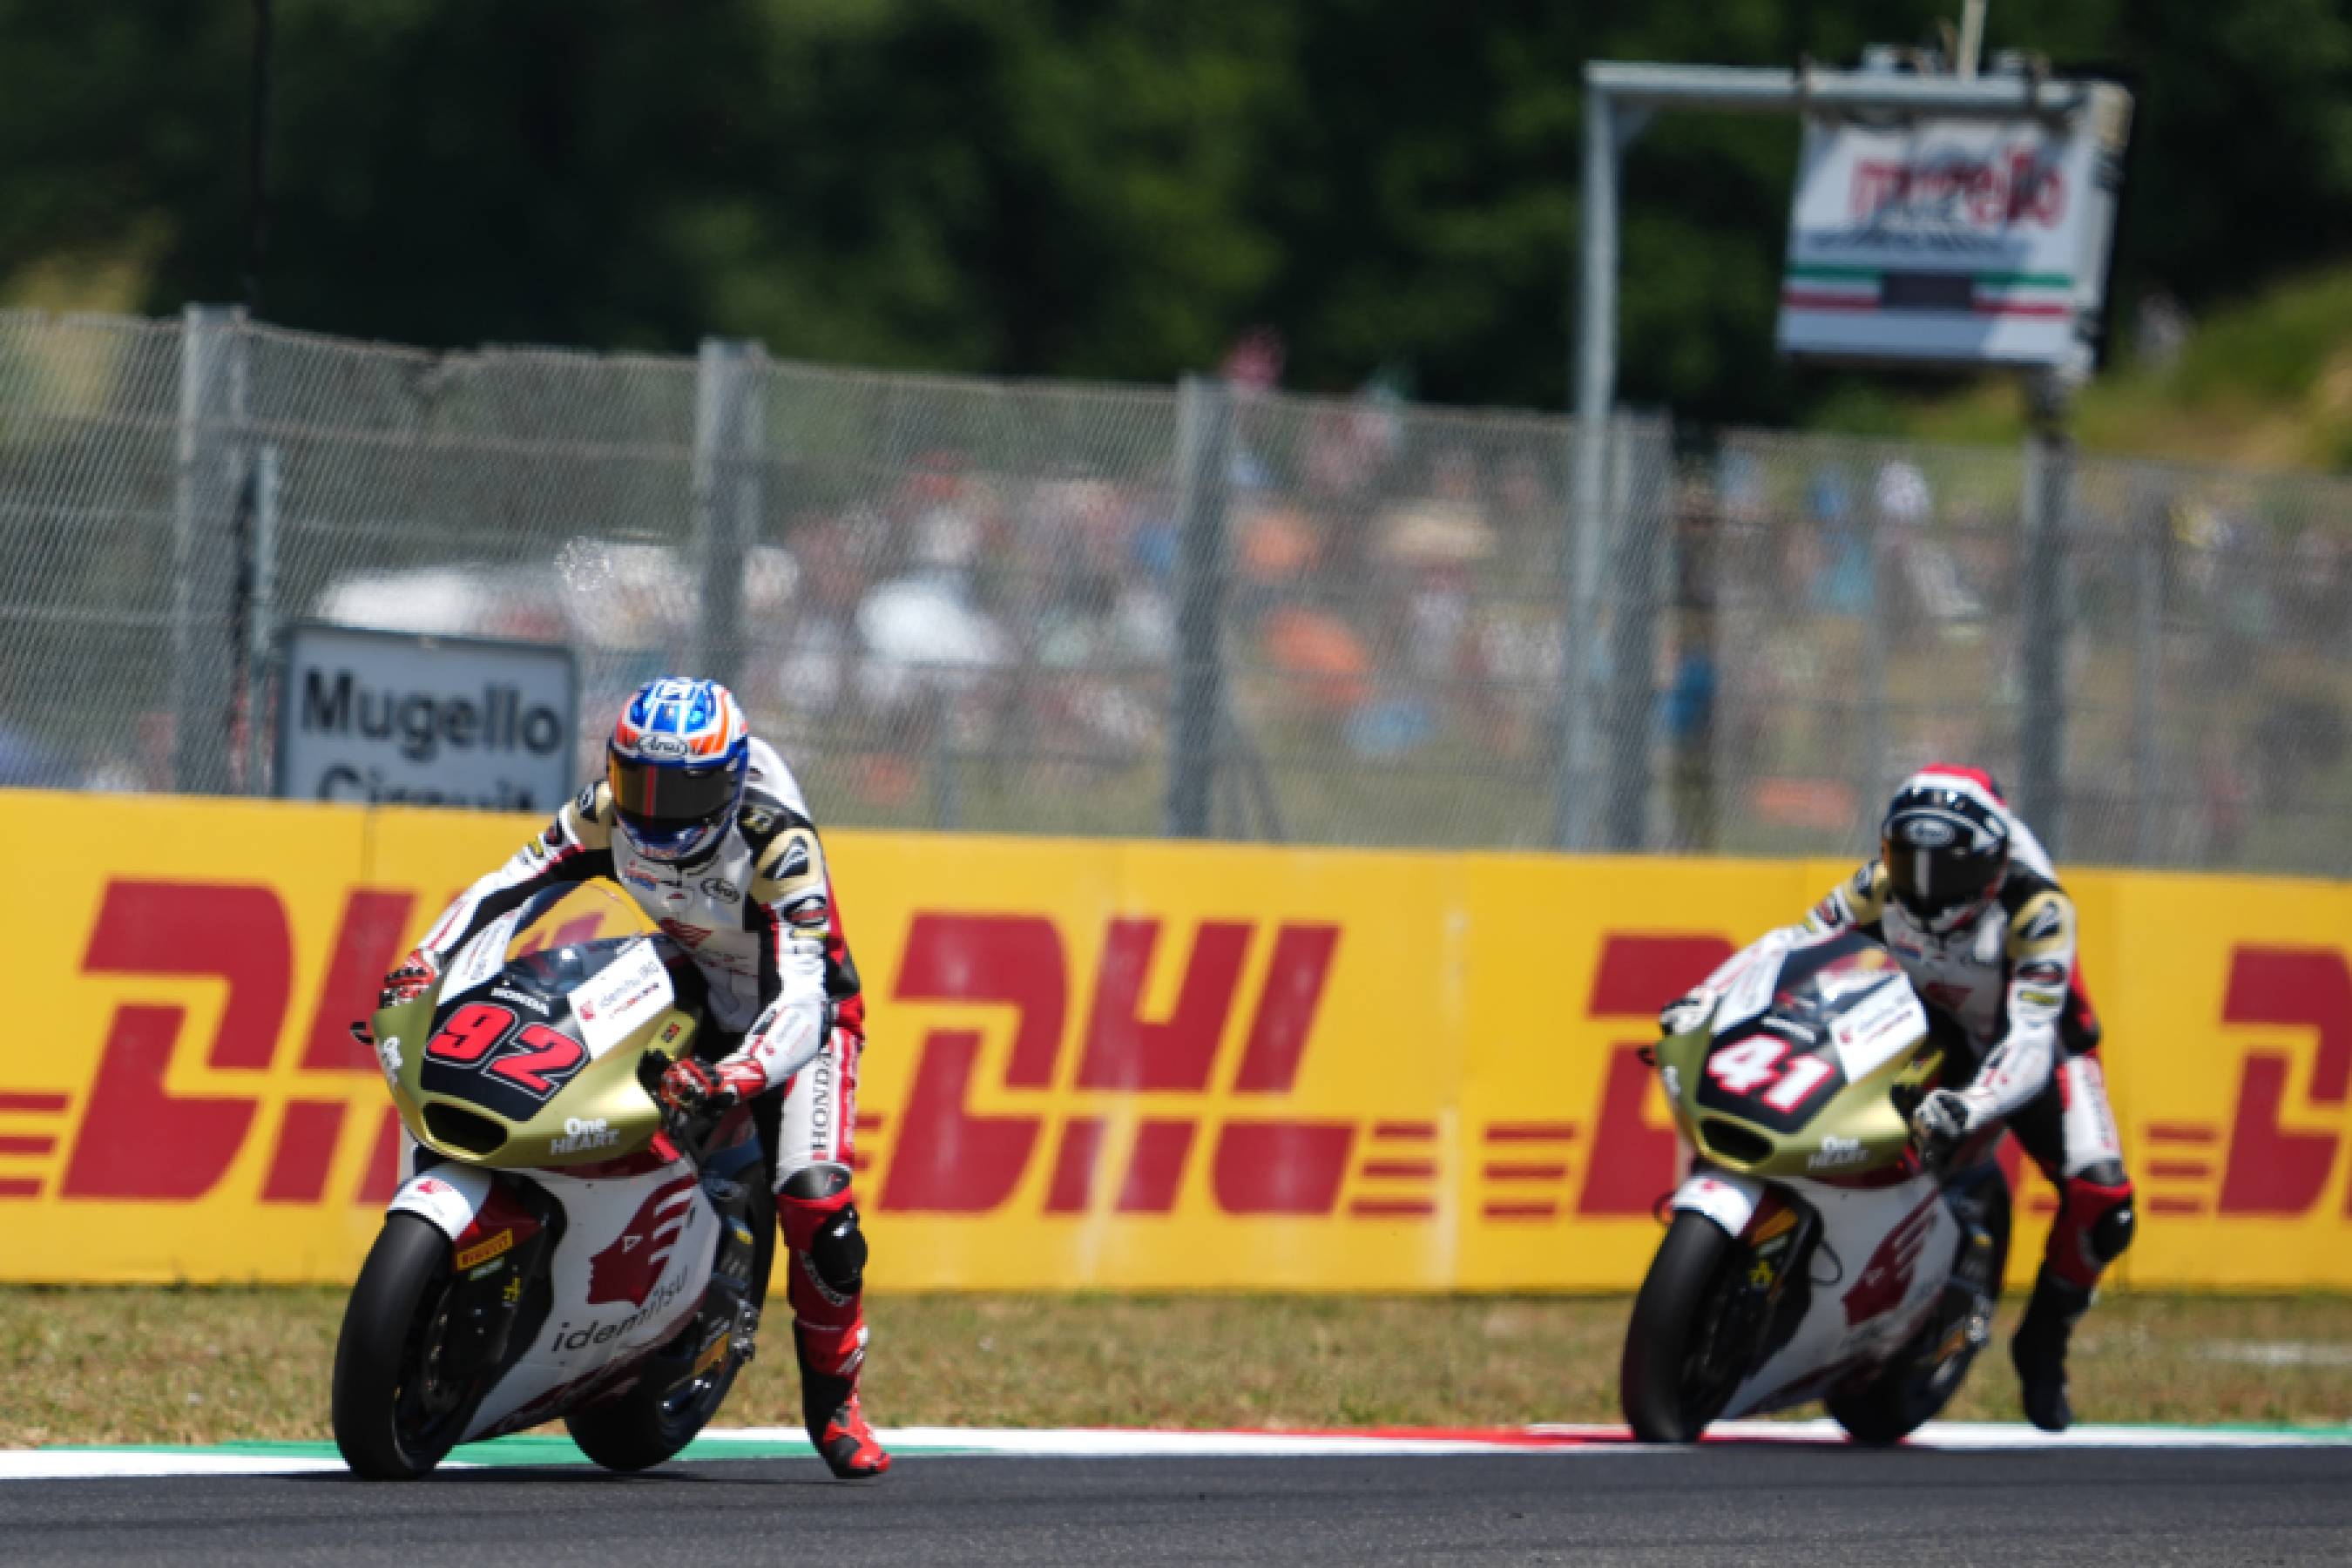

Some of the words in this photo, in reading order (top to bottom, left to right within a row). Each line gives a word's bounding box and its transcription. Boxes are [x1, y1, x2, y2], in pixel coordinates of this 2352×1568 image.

[303, 669, 562, 762] Mugello
[425, 1002, 588, 1098] 92
[876, 912, 1355, 1216] DHL
[1706, 1035, 1835, 1115] 41
[564, 1117, 607, 1136] One
